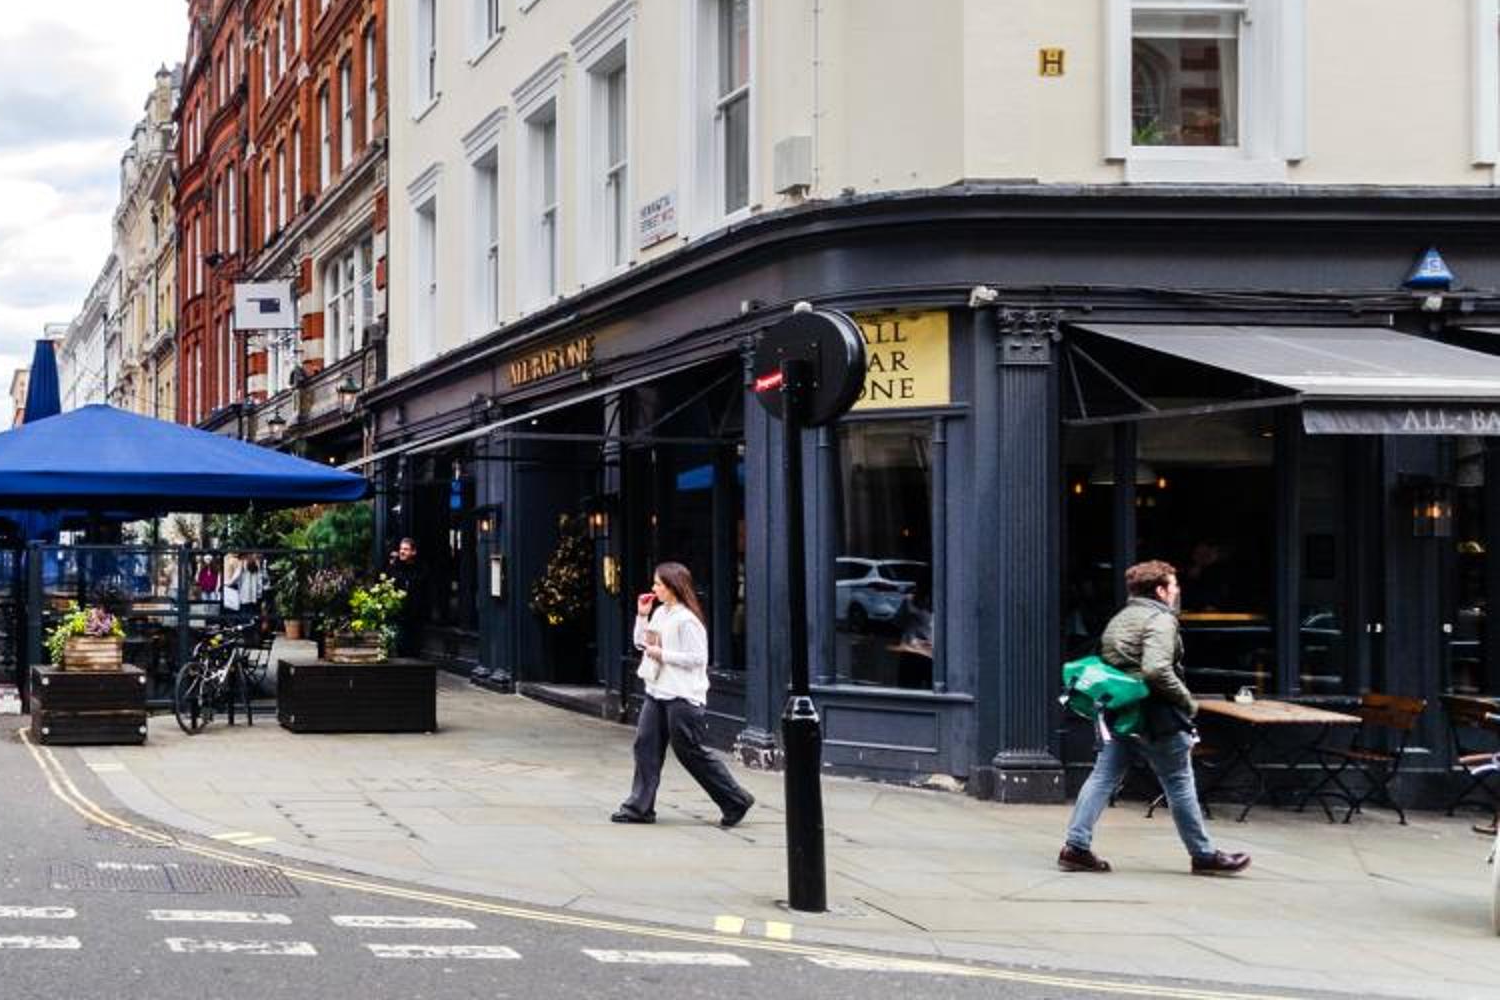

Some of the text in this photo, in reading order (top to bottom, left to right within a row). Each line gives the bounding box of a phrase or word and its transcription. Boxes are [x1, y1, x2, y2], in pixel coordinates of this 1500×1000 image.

[1040, 49, 1064, 75] H
[867, 351, 909, 372] AR
[1402, 409, 1456, 432] ALL
